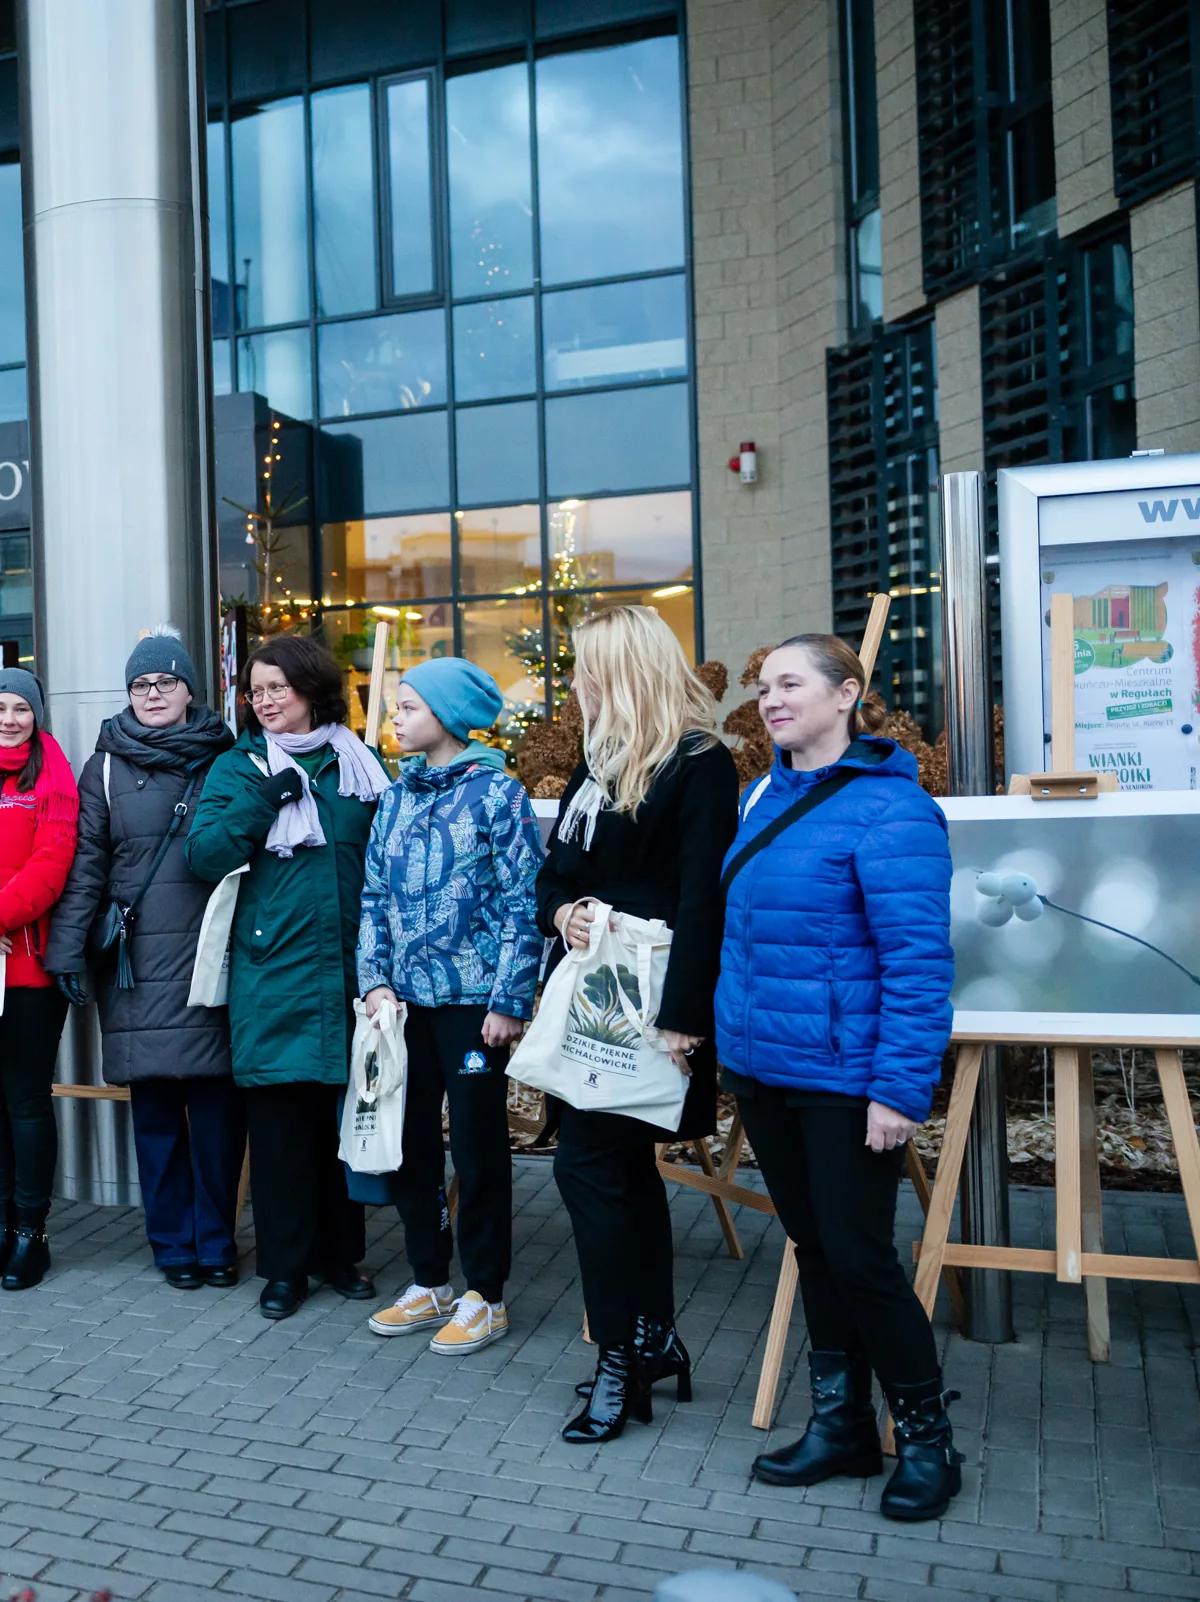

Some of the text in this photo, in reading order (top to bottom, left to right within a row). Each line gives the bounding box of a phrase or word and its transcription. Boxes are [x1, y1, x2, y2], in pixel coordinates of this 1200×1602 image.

[1126, 667, 1172, 676] Centrum
[1074, 677, 1172, 689] kuńczo-Mieszkalne
[1110, 691, 1118, 699] w
[1074, 722, 1104, 730] Miejsce:
[1088, 751, 1142, 768] WIANKI
[566, 1034, 637, 1061] DZIKIE. PIĘKNE.
[588, 1072, 598, 1084] R
